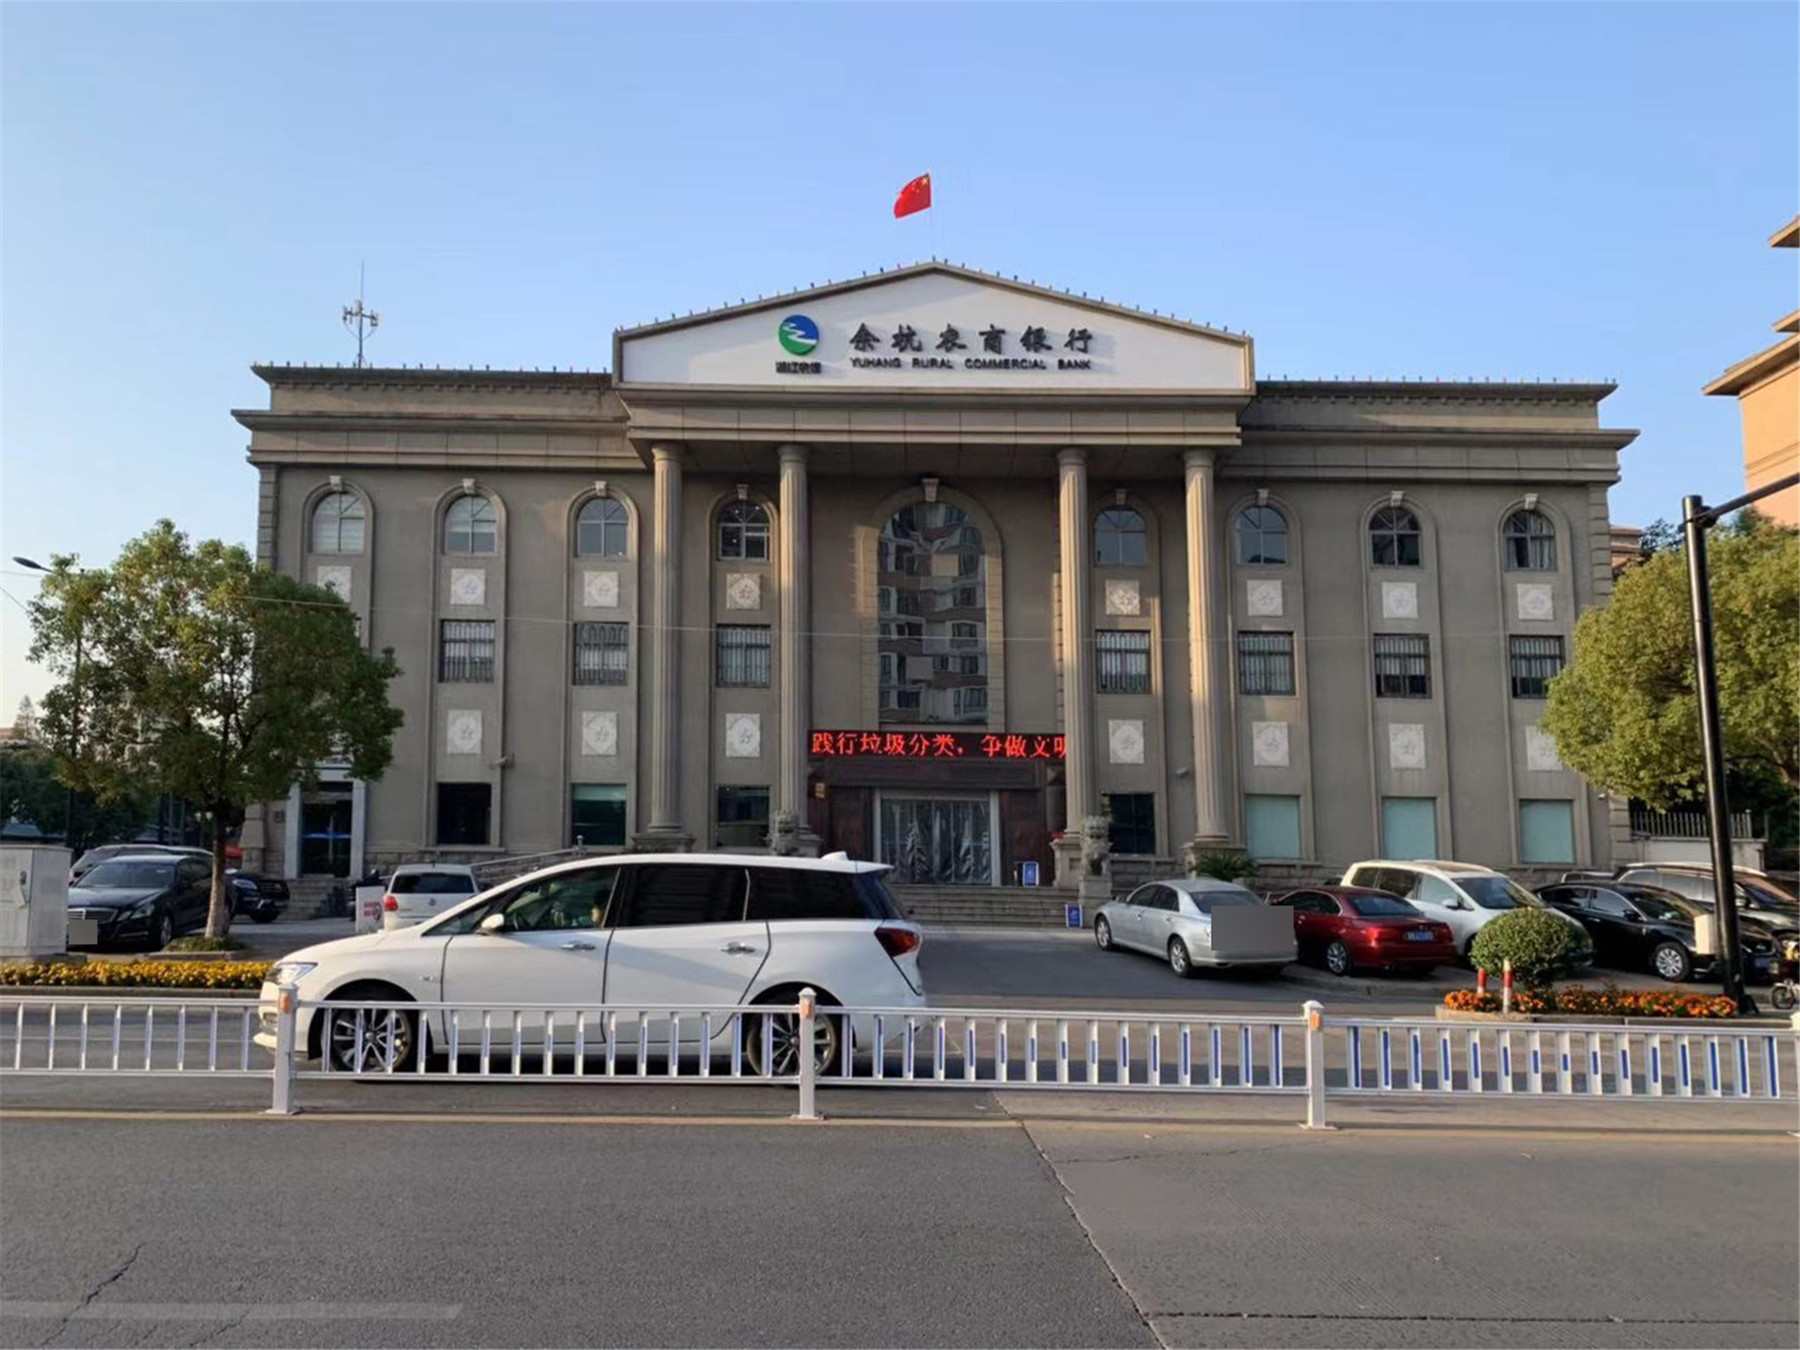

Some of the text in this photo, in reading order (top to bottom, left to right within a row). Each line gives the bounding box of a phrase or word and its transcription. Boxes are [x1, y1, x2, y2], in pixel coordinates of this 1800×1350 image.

[850, 322, 1093, 355] 余杭农商银行
[851, 357, 1091, 370] YUHANG RURAL COMMERCIAL BANK
